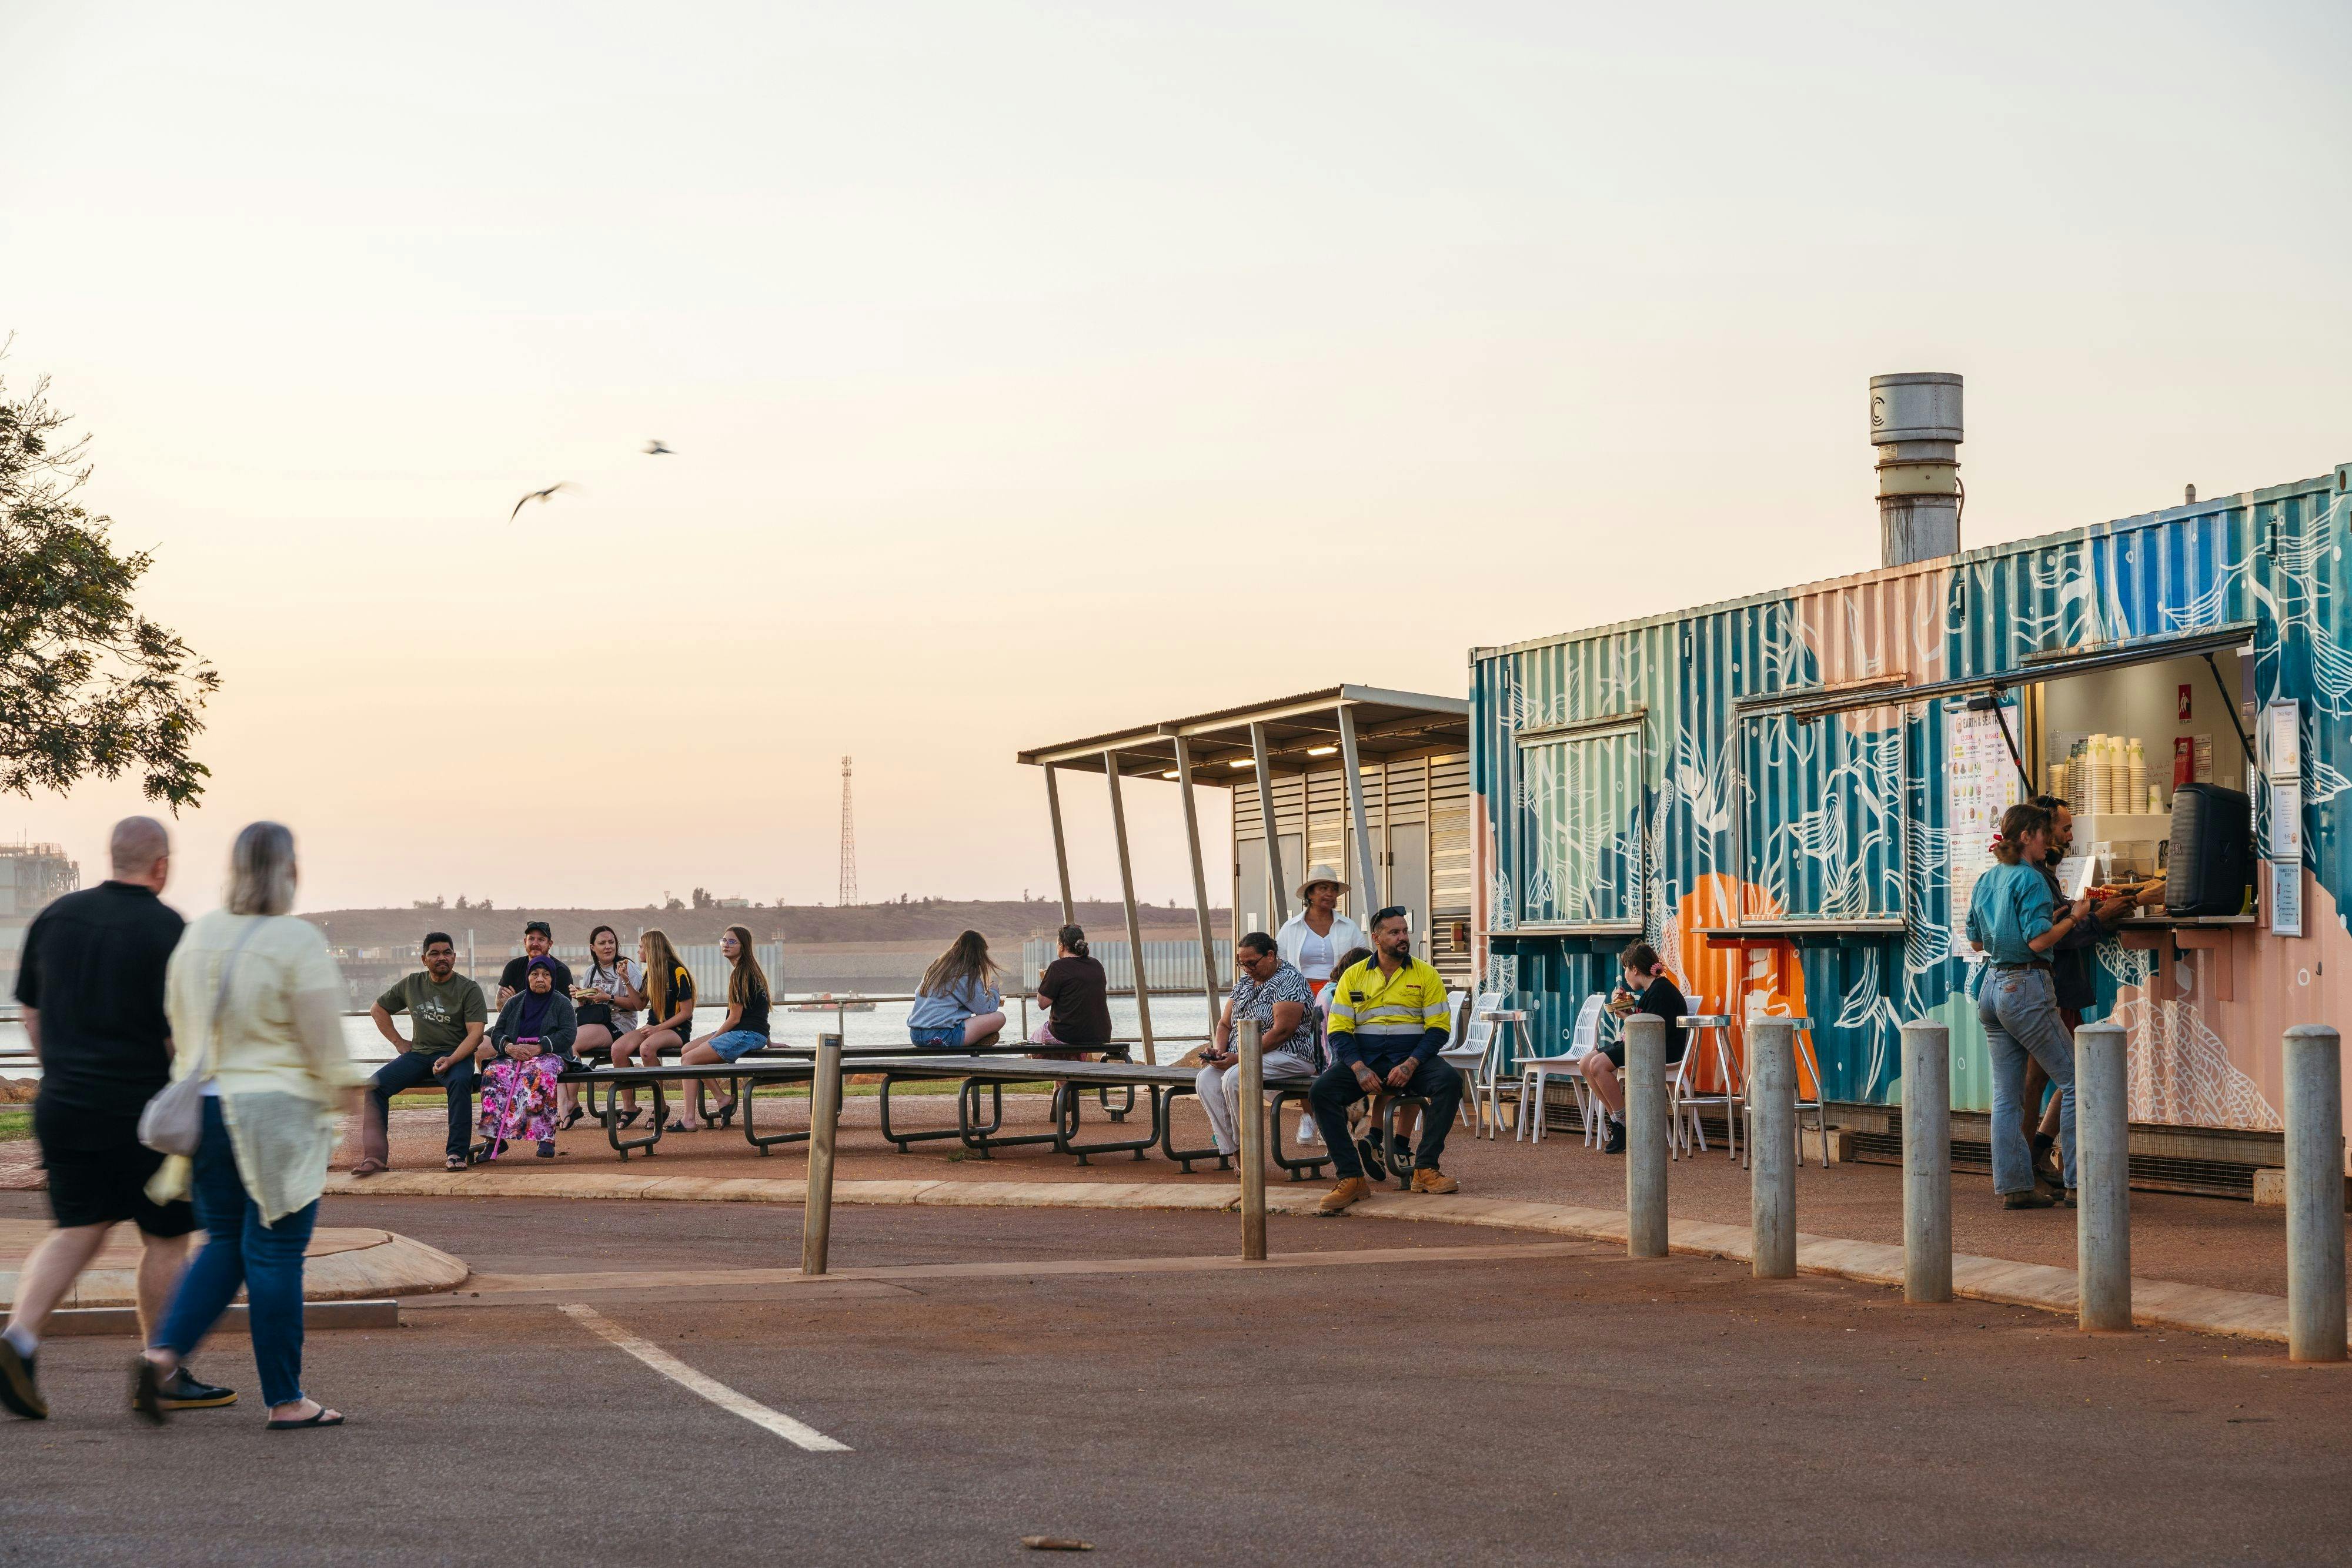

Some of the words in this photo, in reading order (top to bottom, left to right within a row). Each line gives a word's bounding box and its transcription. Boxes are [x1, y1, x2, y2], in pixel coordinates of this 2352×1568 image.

[1963, 717, 1976, 729] EARTH
[1978, 717, 1981, 727] &
[1982, 715, 1992, 726] SEA
[1992, 713, 2009, 725] TRTS
[2173, 844, 2182, 854] JBL
[413, 1009, 450, 1023] aidas
